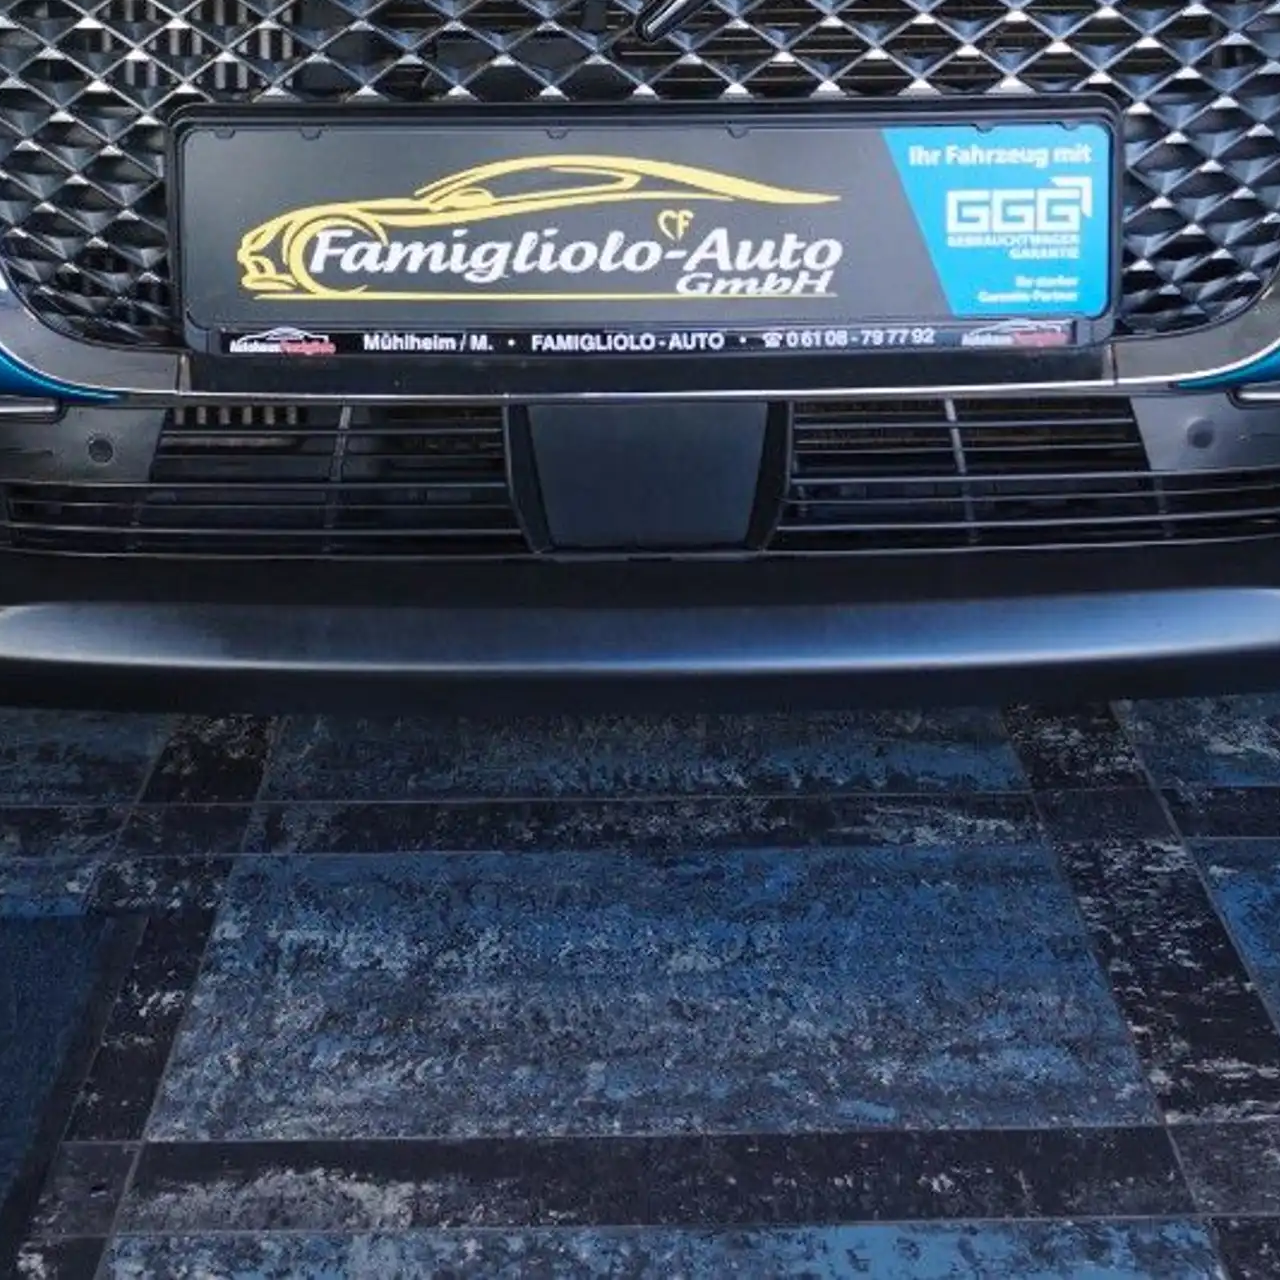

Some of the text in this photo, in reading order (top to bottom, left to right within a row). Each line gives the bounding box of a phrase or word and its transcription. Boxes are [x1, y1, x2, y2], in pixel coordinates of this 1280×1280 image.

[909, 143, 1093, 169] Ihr Fahrzeug mit
[946, 188, 1081, 233] GGG
[676, 270, 835, 296] GmbH
[363, 331, 456, 352] Mühlheim
